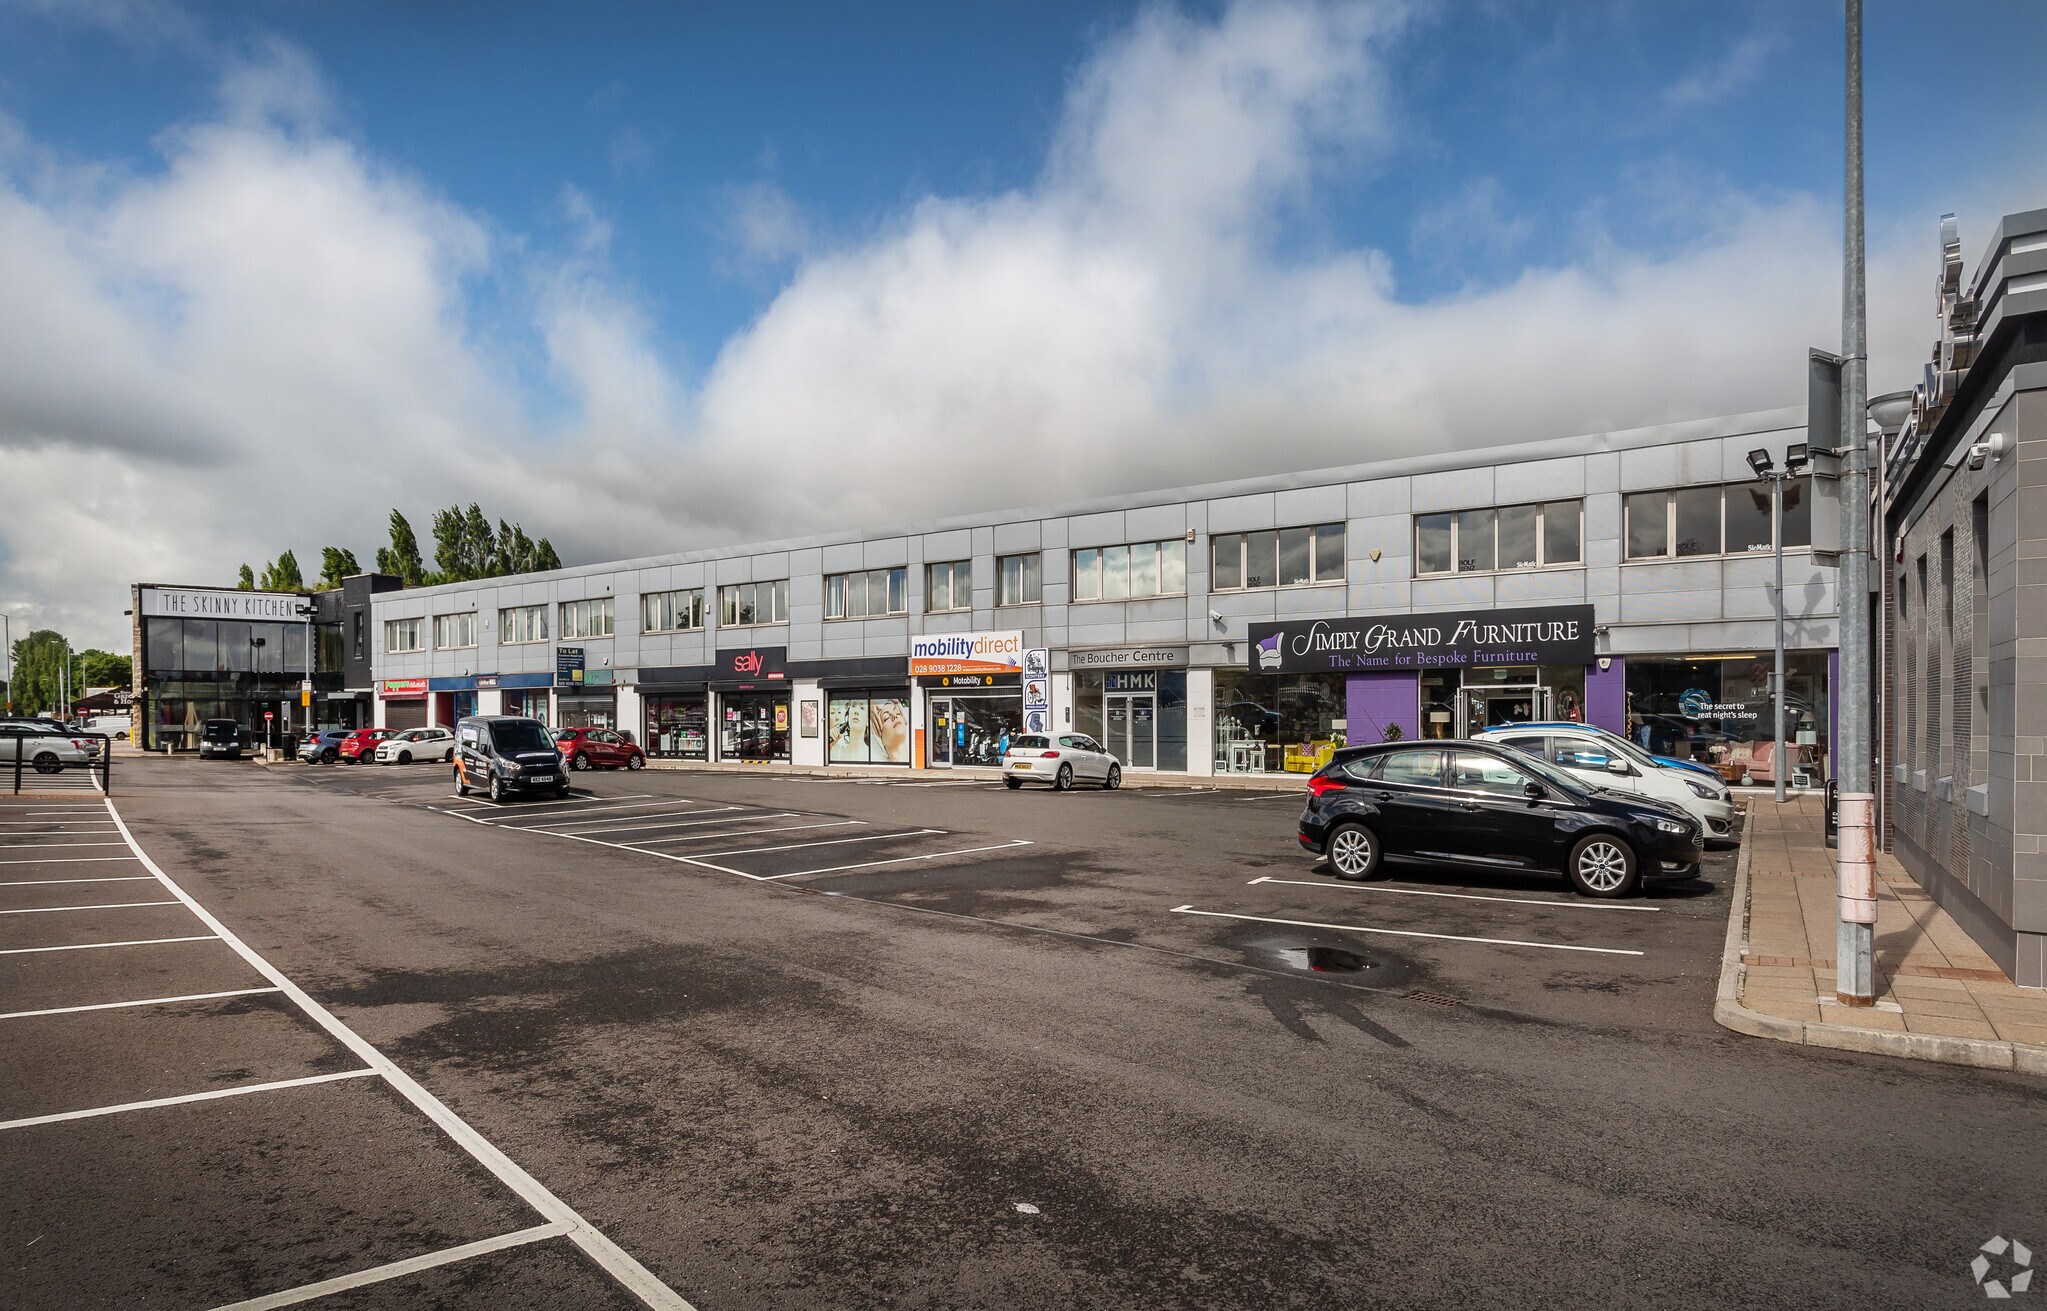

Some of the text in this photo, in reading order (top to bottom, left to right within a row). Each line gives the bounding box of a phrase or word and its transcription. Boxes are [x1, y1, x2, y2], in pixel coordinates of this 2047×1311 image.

[164, 594, 292, 617] THE SKINNY KITCHEN
[1292, 619, 1579, 656] SIMPLY GRAND FURNITURE
[914, 635, 1019, 660] mobilitydirect
[734, 650, 764, 677] sally
[1073, 650, 1174, 665] The Boucher Centre
[1329, 649, 1538, 667] The Name for Bespoke Furniture
[914, 664, 928, 673] 028
[946, 664, 962, 672] 1228
[953, 676, 981, 686] Motobility
[1117, 673, 1154, 689] HMK
[1700, 702, 1713, 710] The
[1713, 711, 1737, 720] night's
[1737, 711, 1758, 720] sleep
